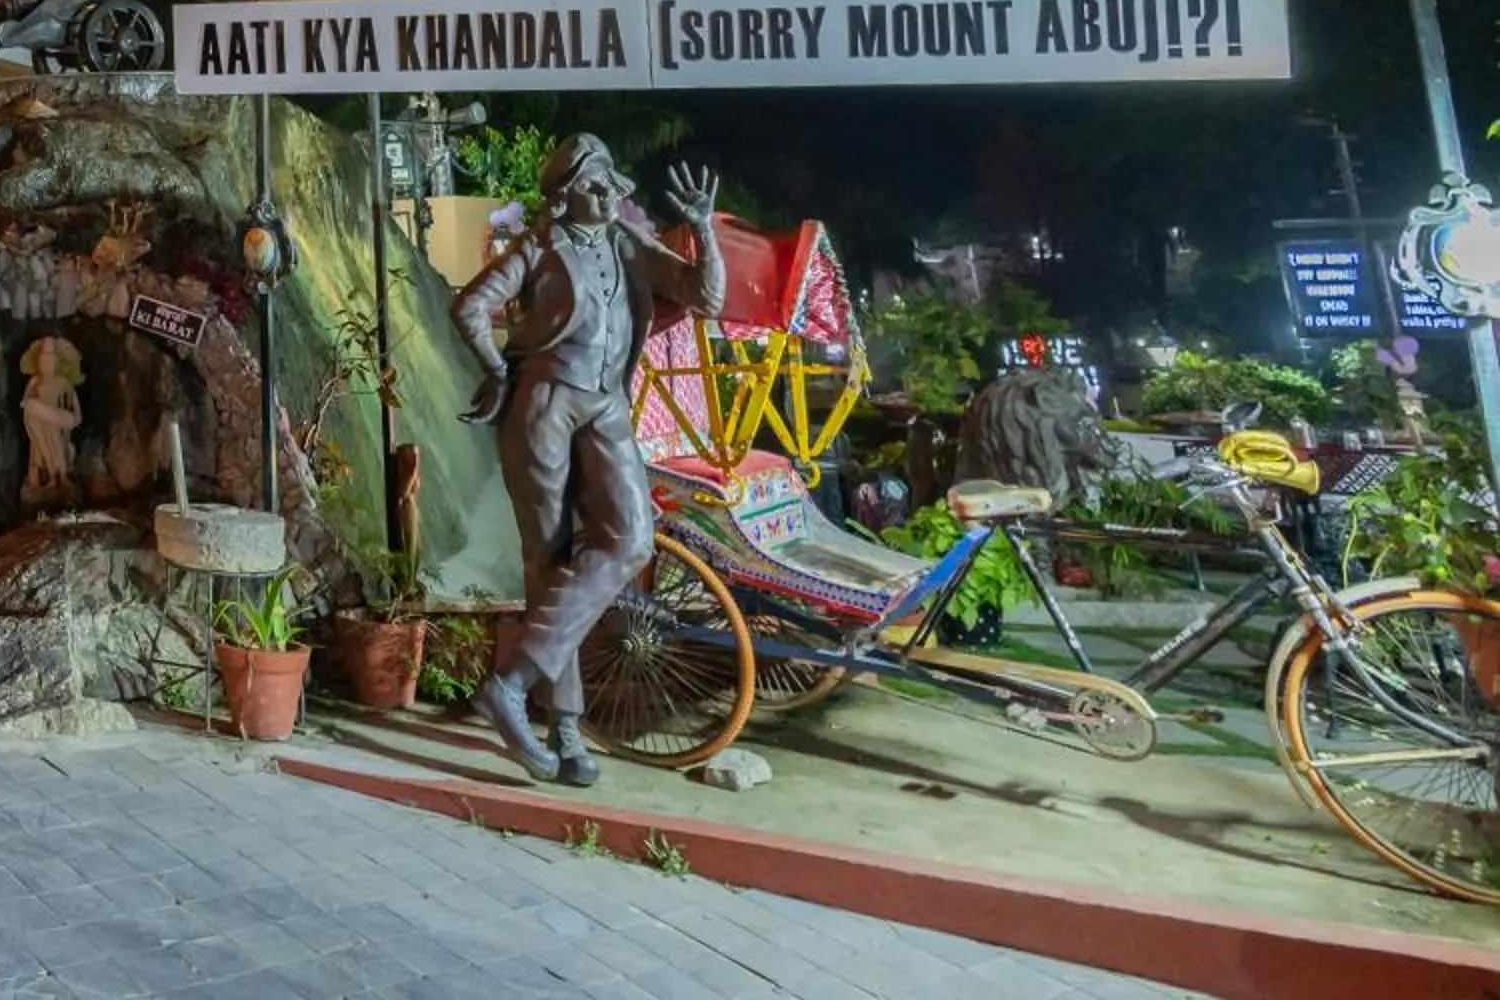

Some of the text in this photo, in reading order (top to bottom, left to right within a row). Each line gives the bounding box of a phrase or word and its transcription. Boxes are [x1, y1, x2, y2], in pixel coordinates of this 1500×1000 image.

[199, 19, 287, 75] AATI
[304, 17, 380, 73] KYA
[396, 8, 626, 71] KHANDALA
[847, 0, 1012, 58] MOUNT
